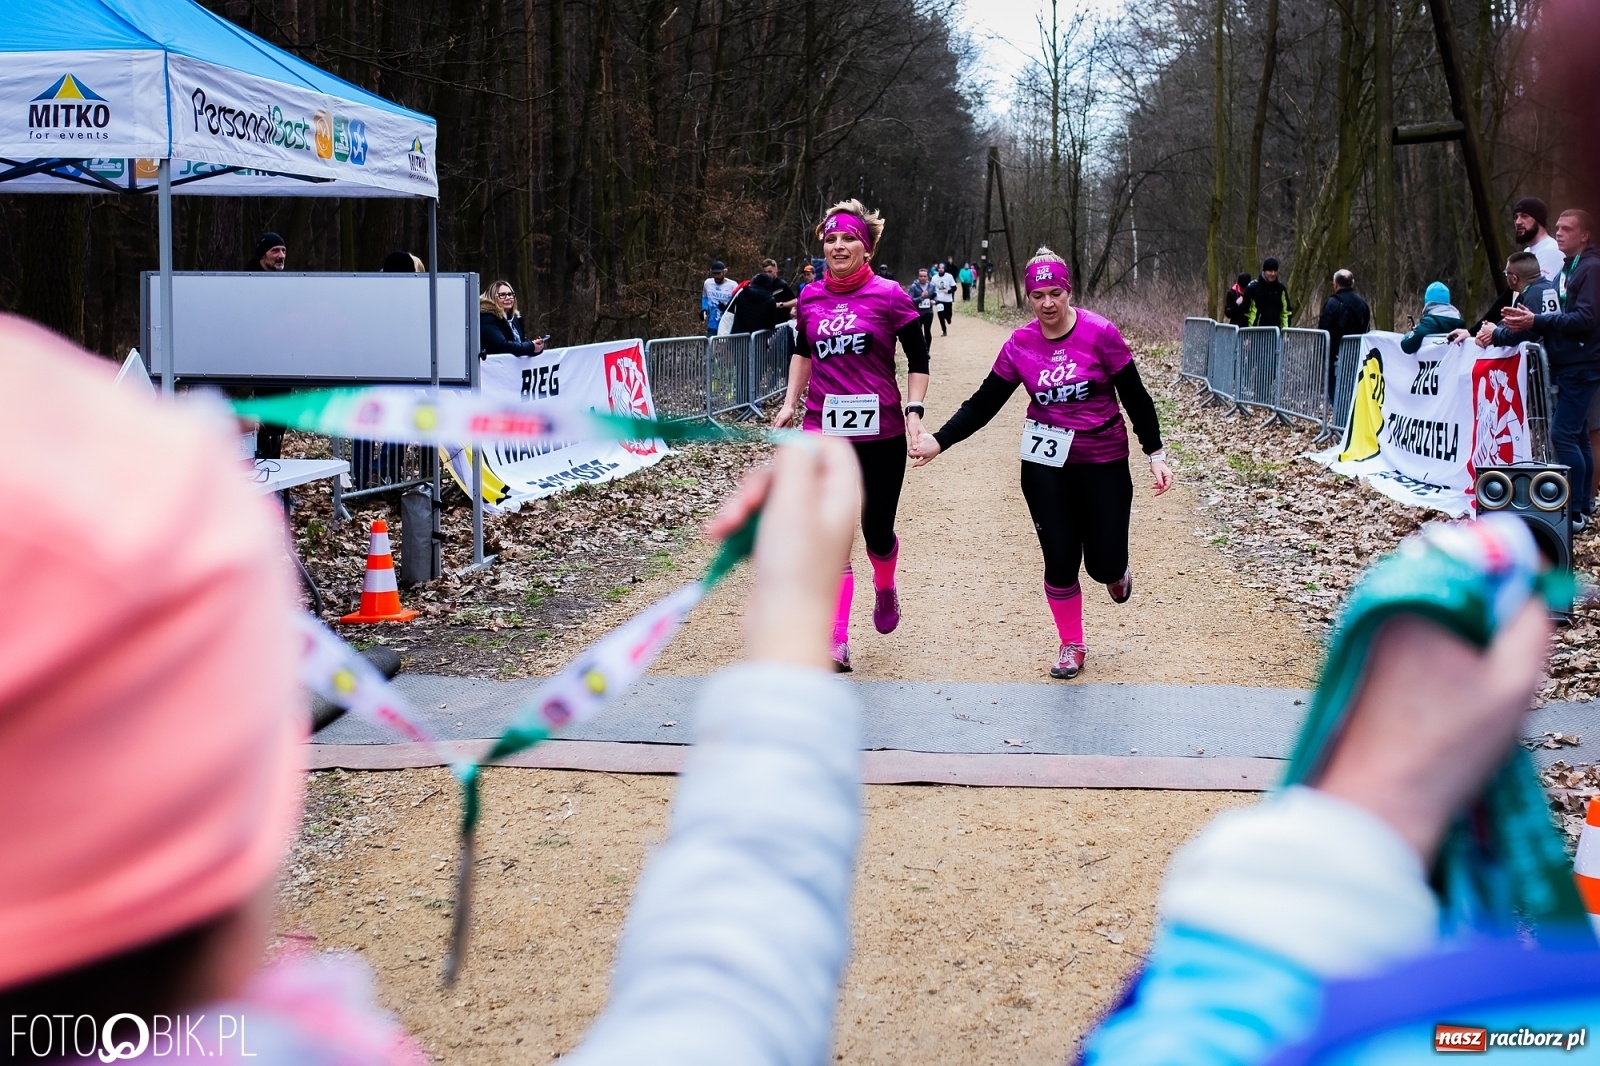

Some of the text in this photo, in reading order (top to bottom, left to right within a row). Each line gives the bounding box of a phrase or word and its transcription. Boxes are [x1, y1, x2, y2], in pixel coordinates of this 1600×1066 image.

[28, 104, 110, 128] MITKO
[191, 87, 311, 151] PersonalBest
[29, 131, 49, 139] for
[817, 310, 858, 336] RÓŻ
[815, 332, 867, 359] DUPĘ
[520, 363, 561, 402] BIEG
[1037, 358, 1078, 387] RÓŻ
[1410, 360, 1442, 396] BIEG
[1034, 380, 1090, 406] DUPĘ
[826, 409, 876, 429] 127
[1030, 435, 1058, 458] 73
[1387, 412, 1459, 463] TWARDZIELA
